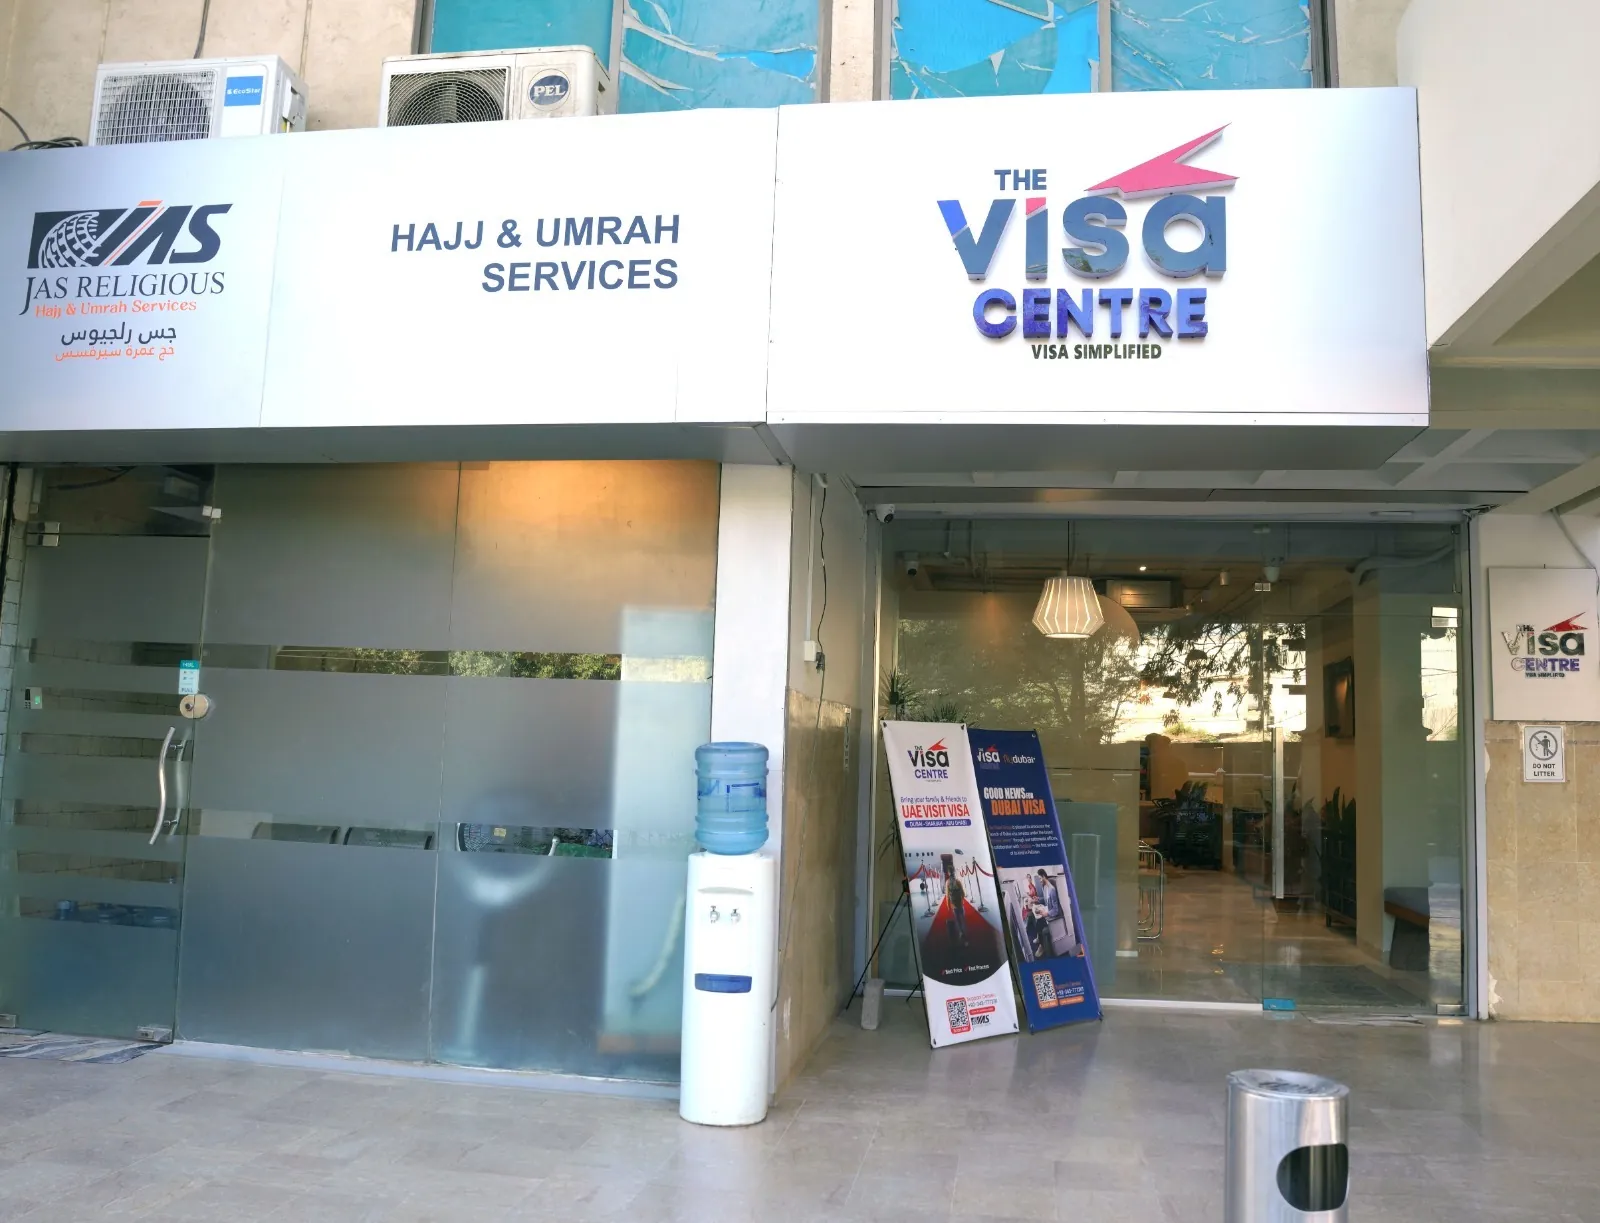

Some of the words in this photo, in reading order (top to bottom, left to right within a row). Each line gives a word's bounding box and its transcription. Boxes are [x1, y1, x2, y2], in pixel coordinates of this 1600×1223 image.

[533, 85, 566, 97] PEL
[994, 169, 1047, 190] THE
[391, 221, 484, 252] HAJJ
[496, 219, 522, 248] &
[536, 214, 680, 248] UMRAH
[481, 258, 679, 293] SERVICES
[19, 276, 68, 316] JAS
[76, 271, 226, 298] RELIGIOUS
[35, 304, 62, 319] Hajj
[66, 303, 77, 316] &
[80, 300, 128, 316] Umrah
[131, 299, 198, 314] Services
[972, 288, 1209, 339] CENTRE
[61, 321, 133, 346] رلجيوس
[138, 327, 177, 345] جس
[158, 345, 176, 361] حج
[1031, 344, 1069, 359] VISA
[1073, 343, 1162, 359] SIMPLIFIED
[1511, 657, 1580, 671] CENTRE
[914, 769, 949, 779] CENTRE
[984, 787, 1004, 799] GOOD
[1004, 787, 1026, 799] NEWS
[902, 805, 923, 818] UAE
[923, 804, 946, 818] VISIT
[947, 804, 970, 817] VISA
[991, 800, 1021, 816] DUBAI
[1022, 799, 1047, 815] VISA
